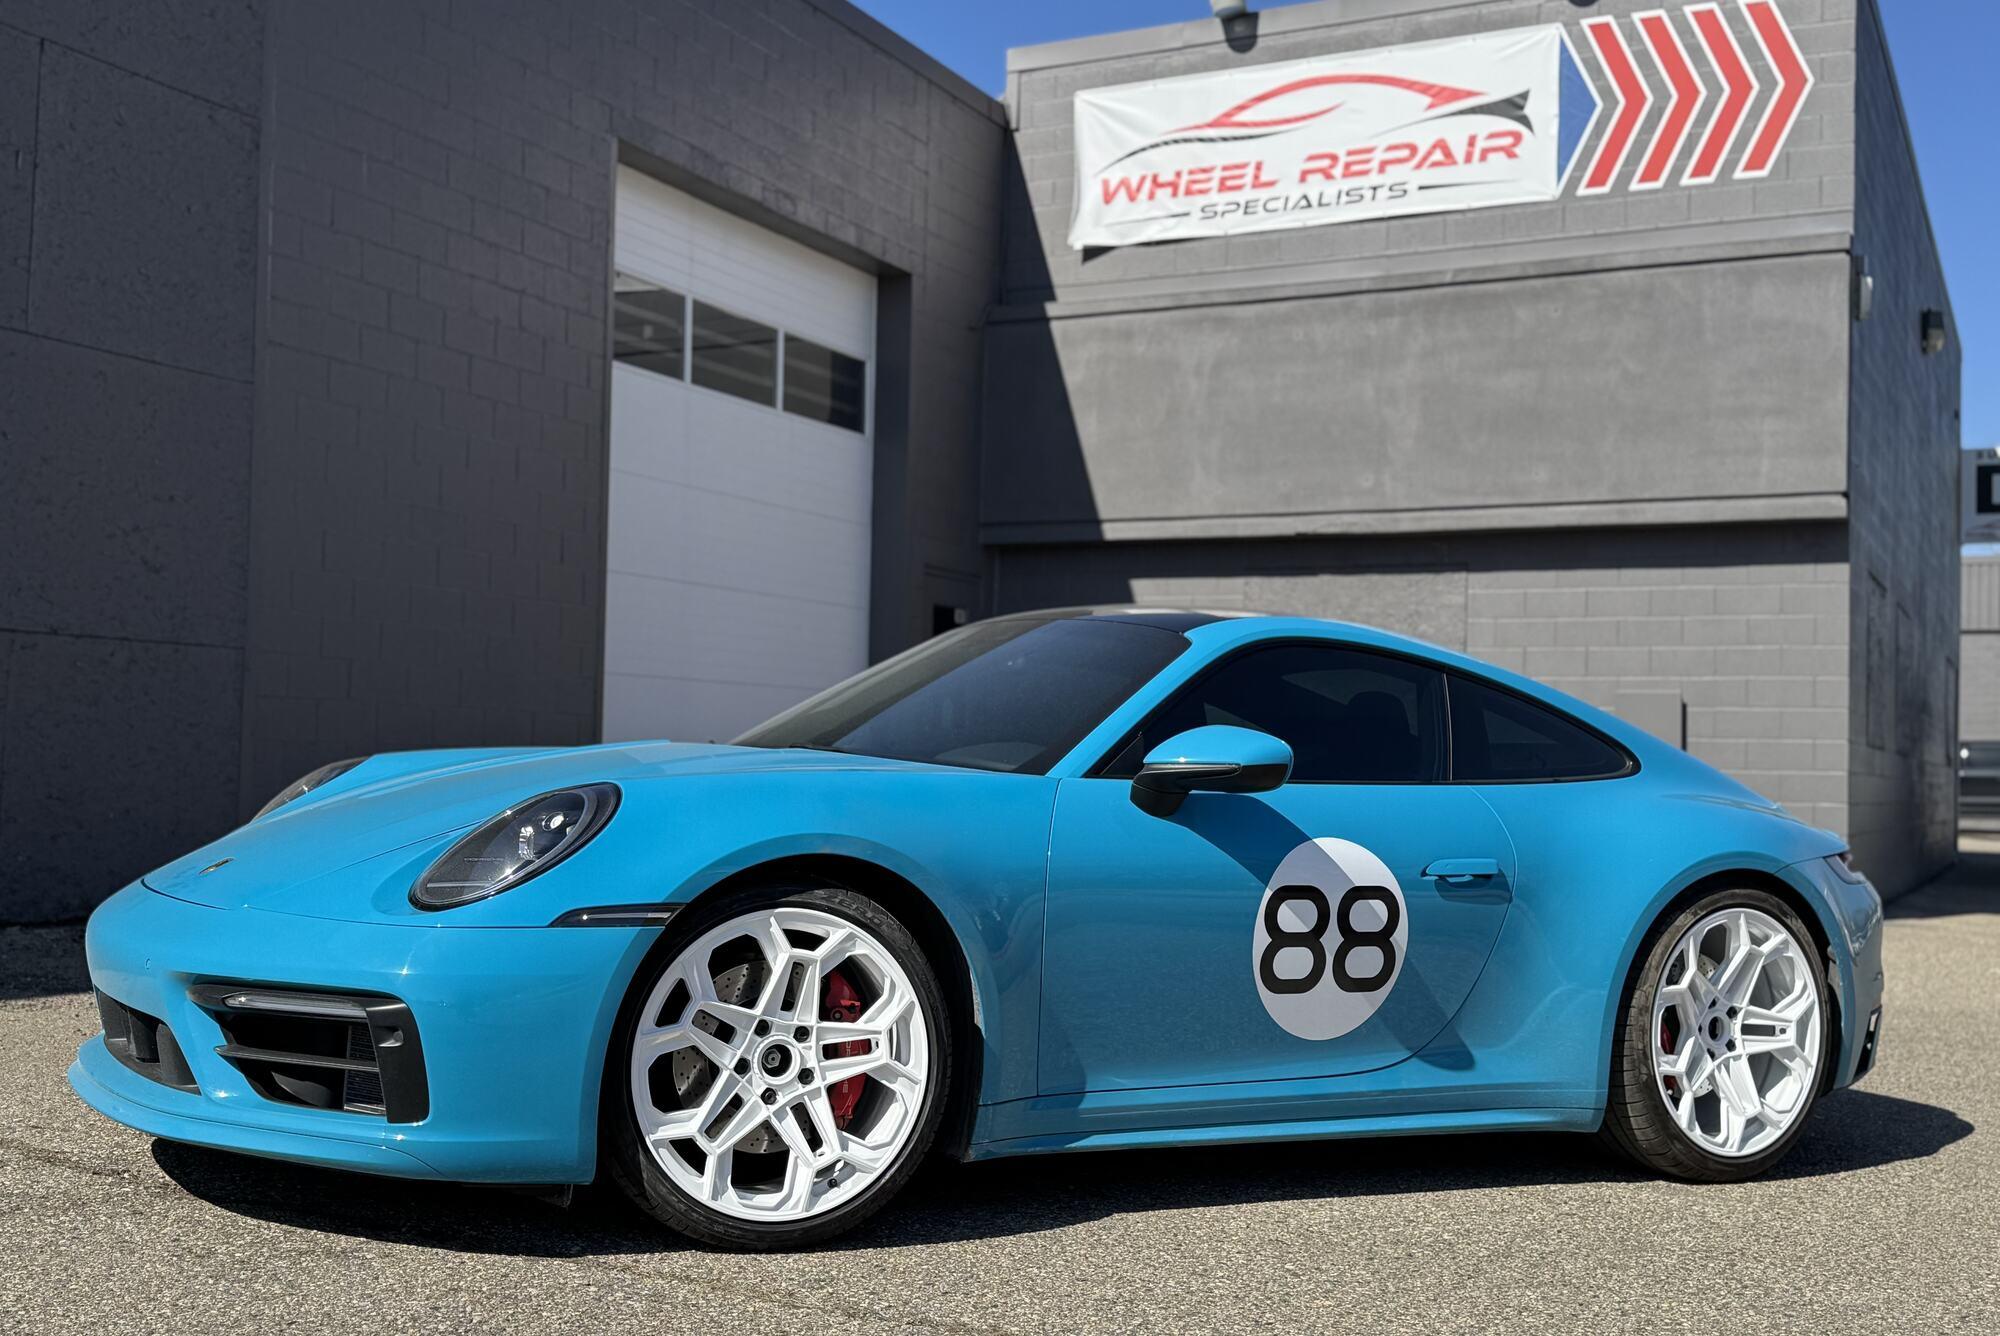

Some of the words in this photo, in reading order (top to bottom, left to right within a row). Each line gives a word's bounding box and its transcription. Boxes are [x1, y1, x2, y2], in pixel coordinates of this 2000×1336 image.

[1102, 160, 1280, 205] WHEEL
[1298, 130, 1523, 183] REPAIR
[1200, 181, 1408, 220] SPECIALISTS
[1260, 884, 1400, 995] 88
